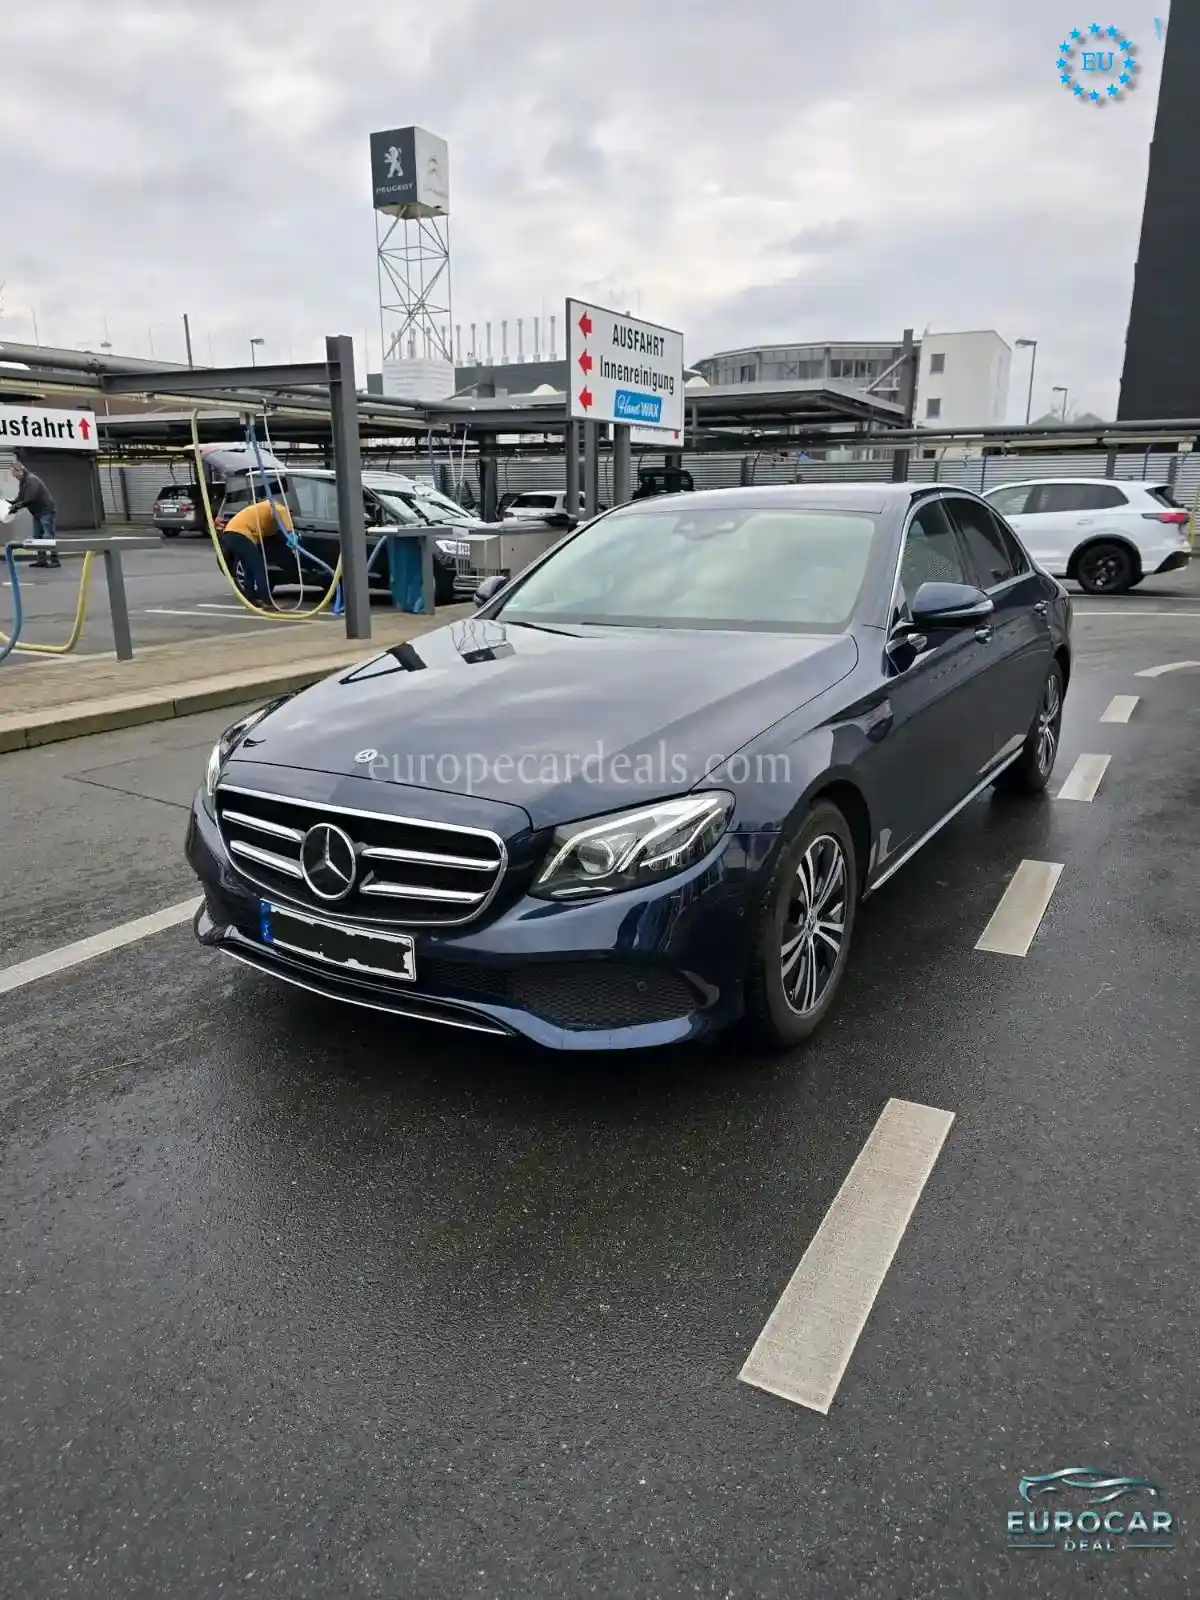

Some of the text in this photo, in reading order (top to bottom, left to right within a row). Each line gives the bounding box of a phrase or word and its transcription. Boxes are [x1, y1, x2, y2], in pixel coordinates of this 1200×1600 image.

[376, 182, 414, 196] PEUGEOT
[612, 323, 664, 357] AUSFAHRT
[600, 355, 674, 395] Innenreinigung
